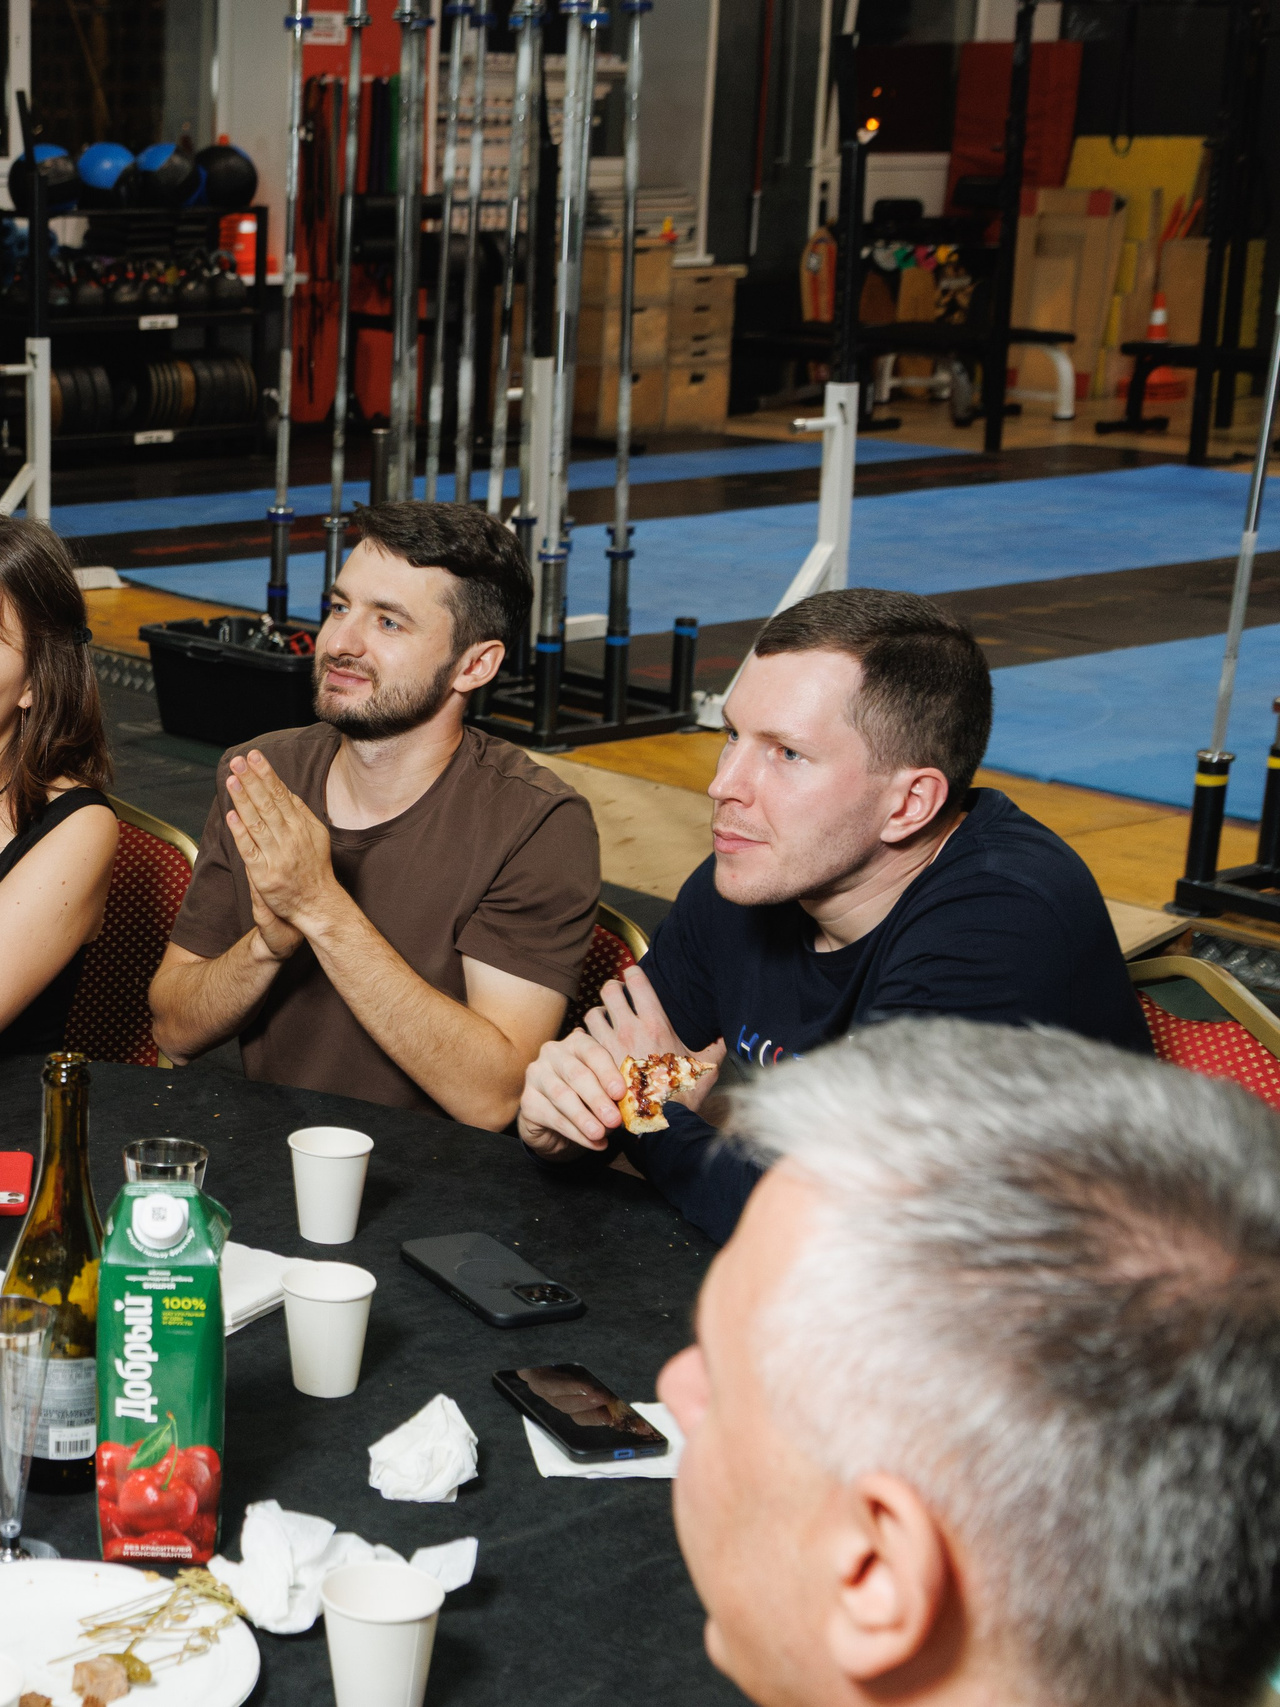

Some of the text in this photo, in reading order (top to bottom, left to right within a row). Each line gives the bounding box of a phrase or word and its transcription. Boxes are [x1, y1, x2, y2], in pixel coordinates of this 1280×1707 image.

[162, 1296, 207, 1311] 100%
[114, 1293, 159, 1423] Добрый
[141, 1545, 192, 1553] КРАСИТЕЛЕЙ
